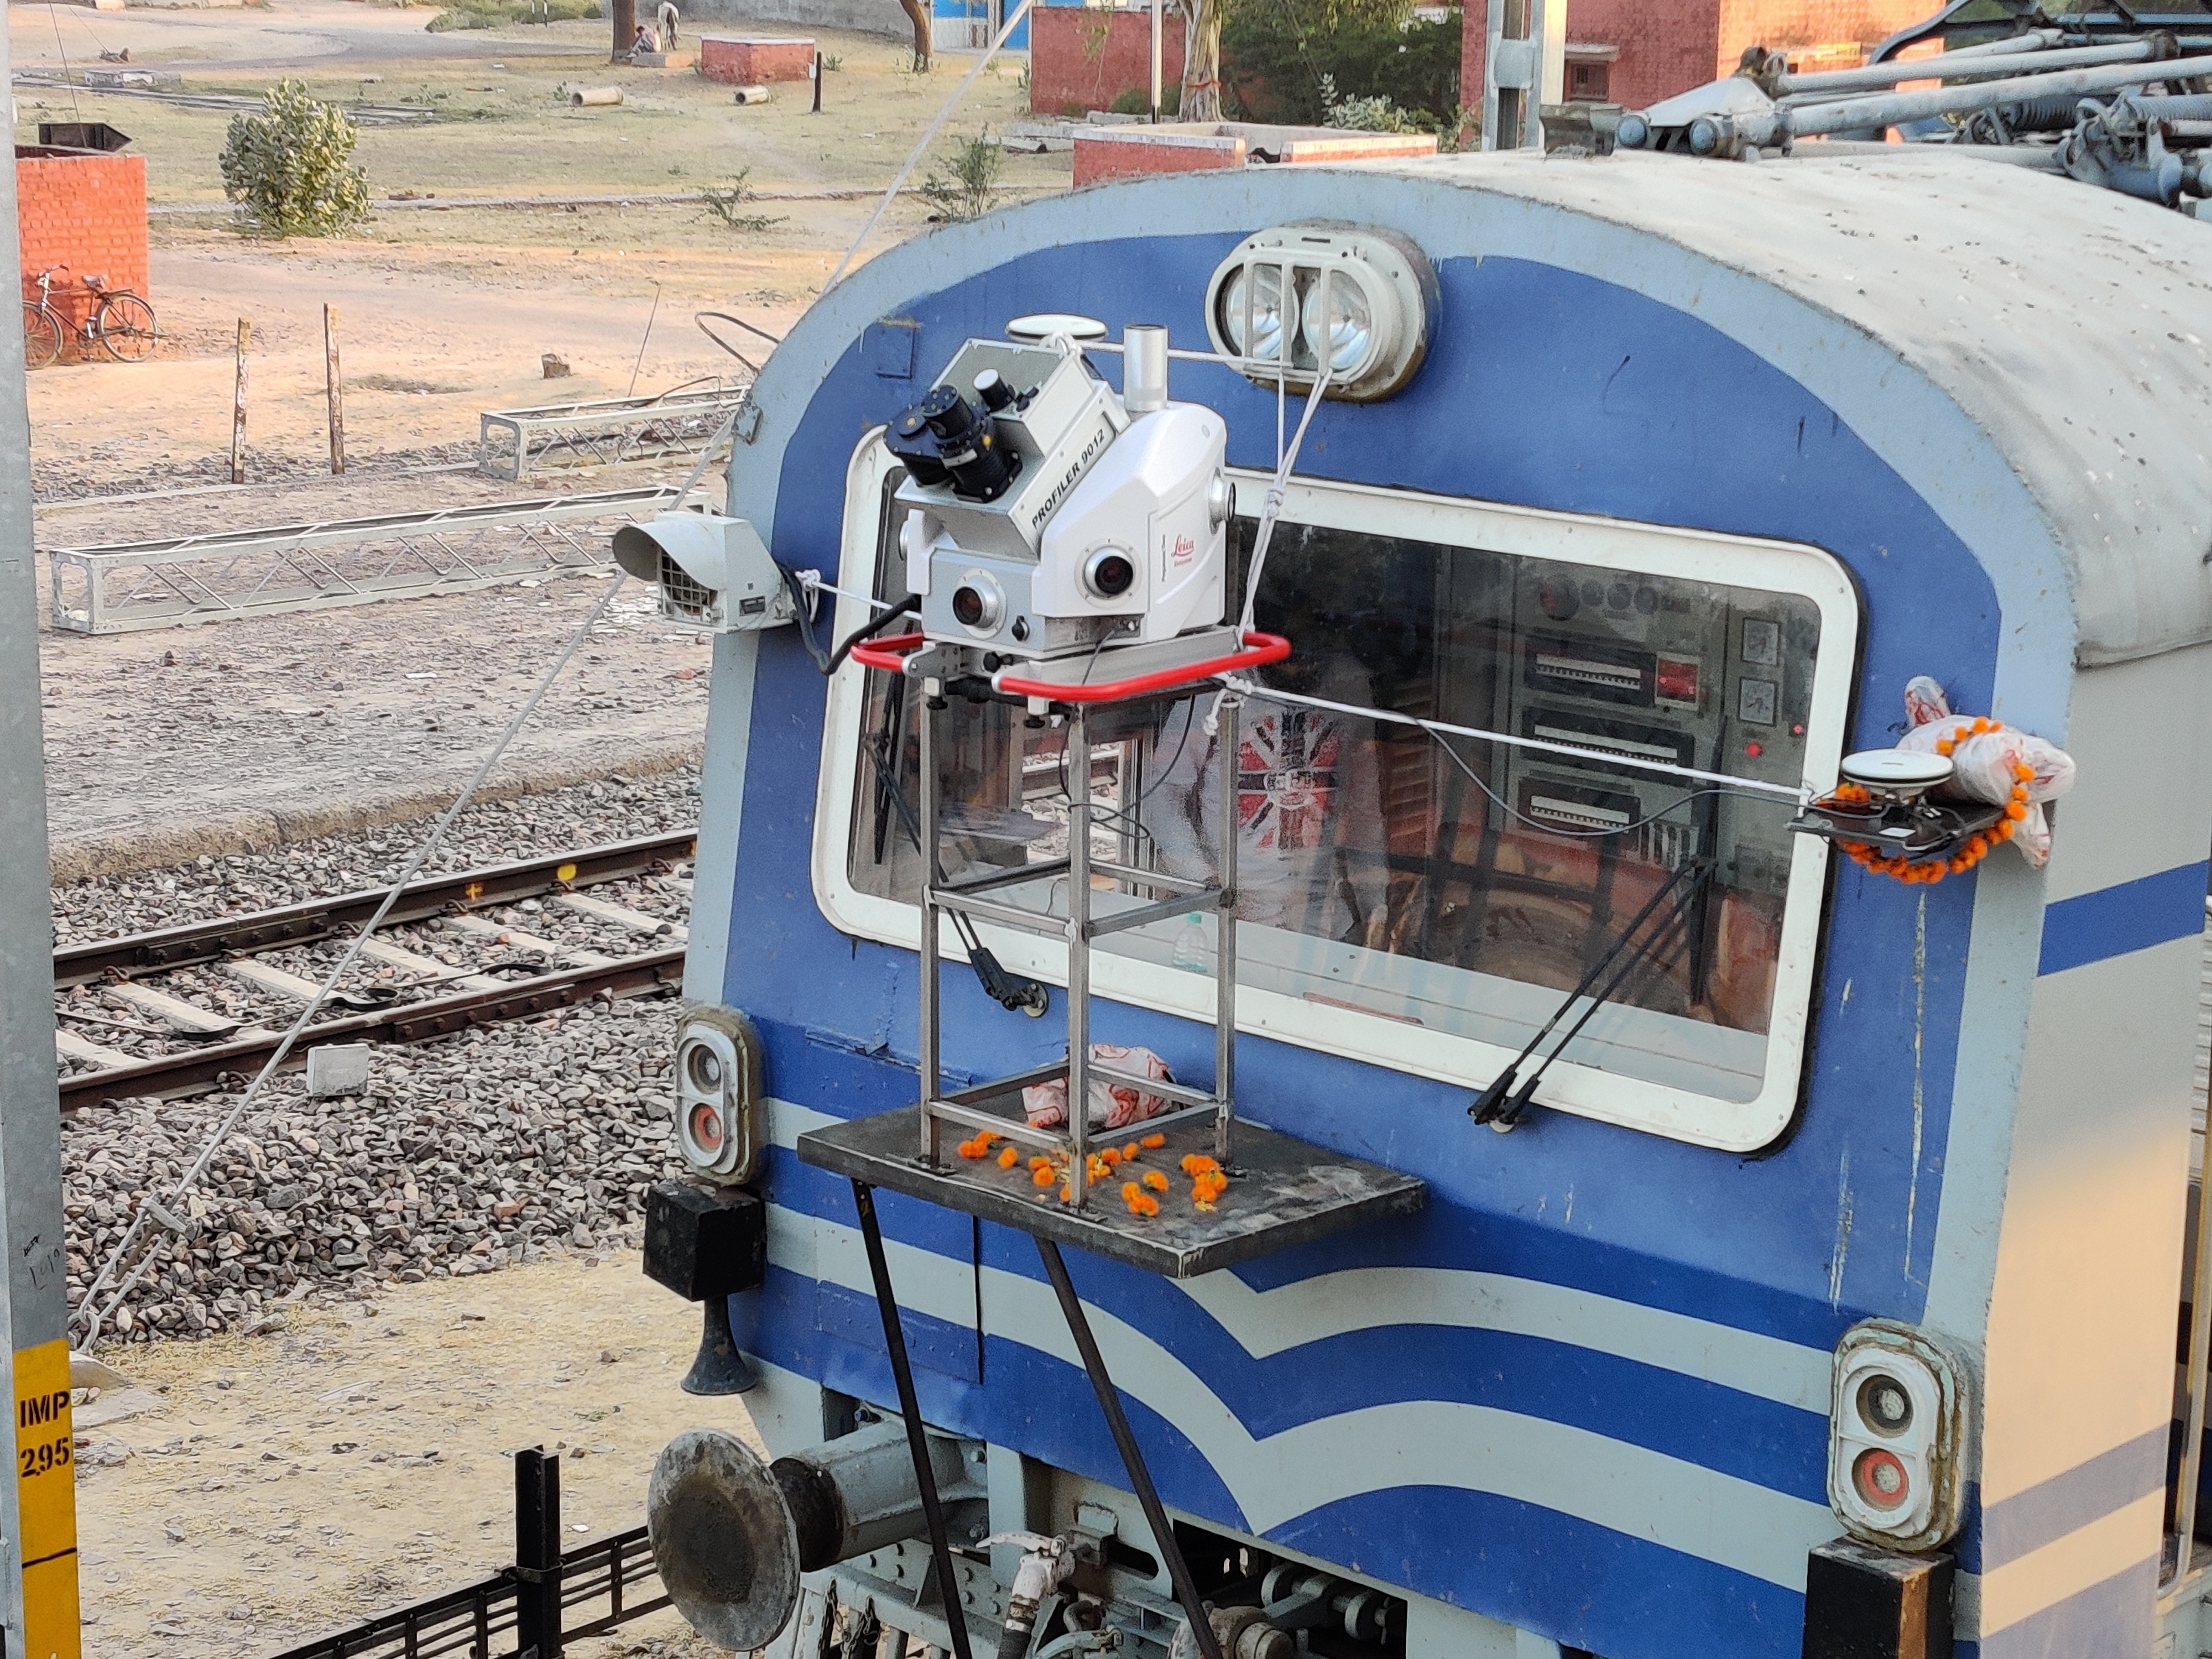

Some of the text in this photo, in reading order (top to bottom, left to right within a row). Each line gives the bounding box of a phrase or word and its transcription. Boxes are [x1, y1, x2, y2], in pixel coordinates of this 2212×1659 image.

[1032, 429, 1105, 529] PROFILER 9012
[1171, 534, 1194, 557] Leica
[20, 1390, 70, 1428] IMP
